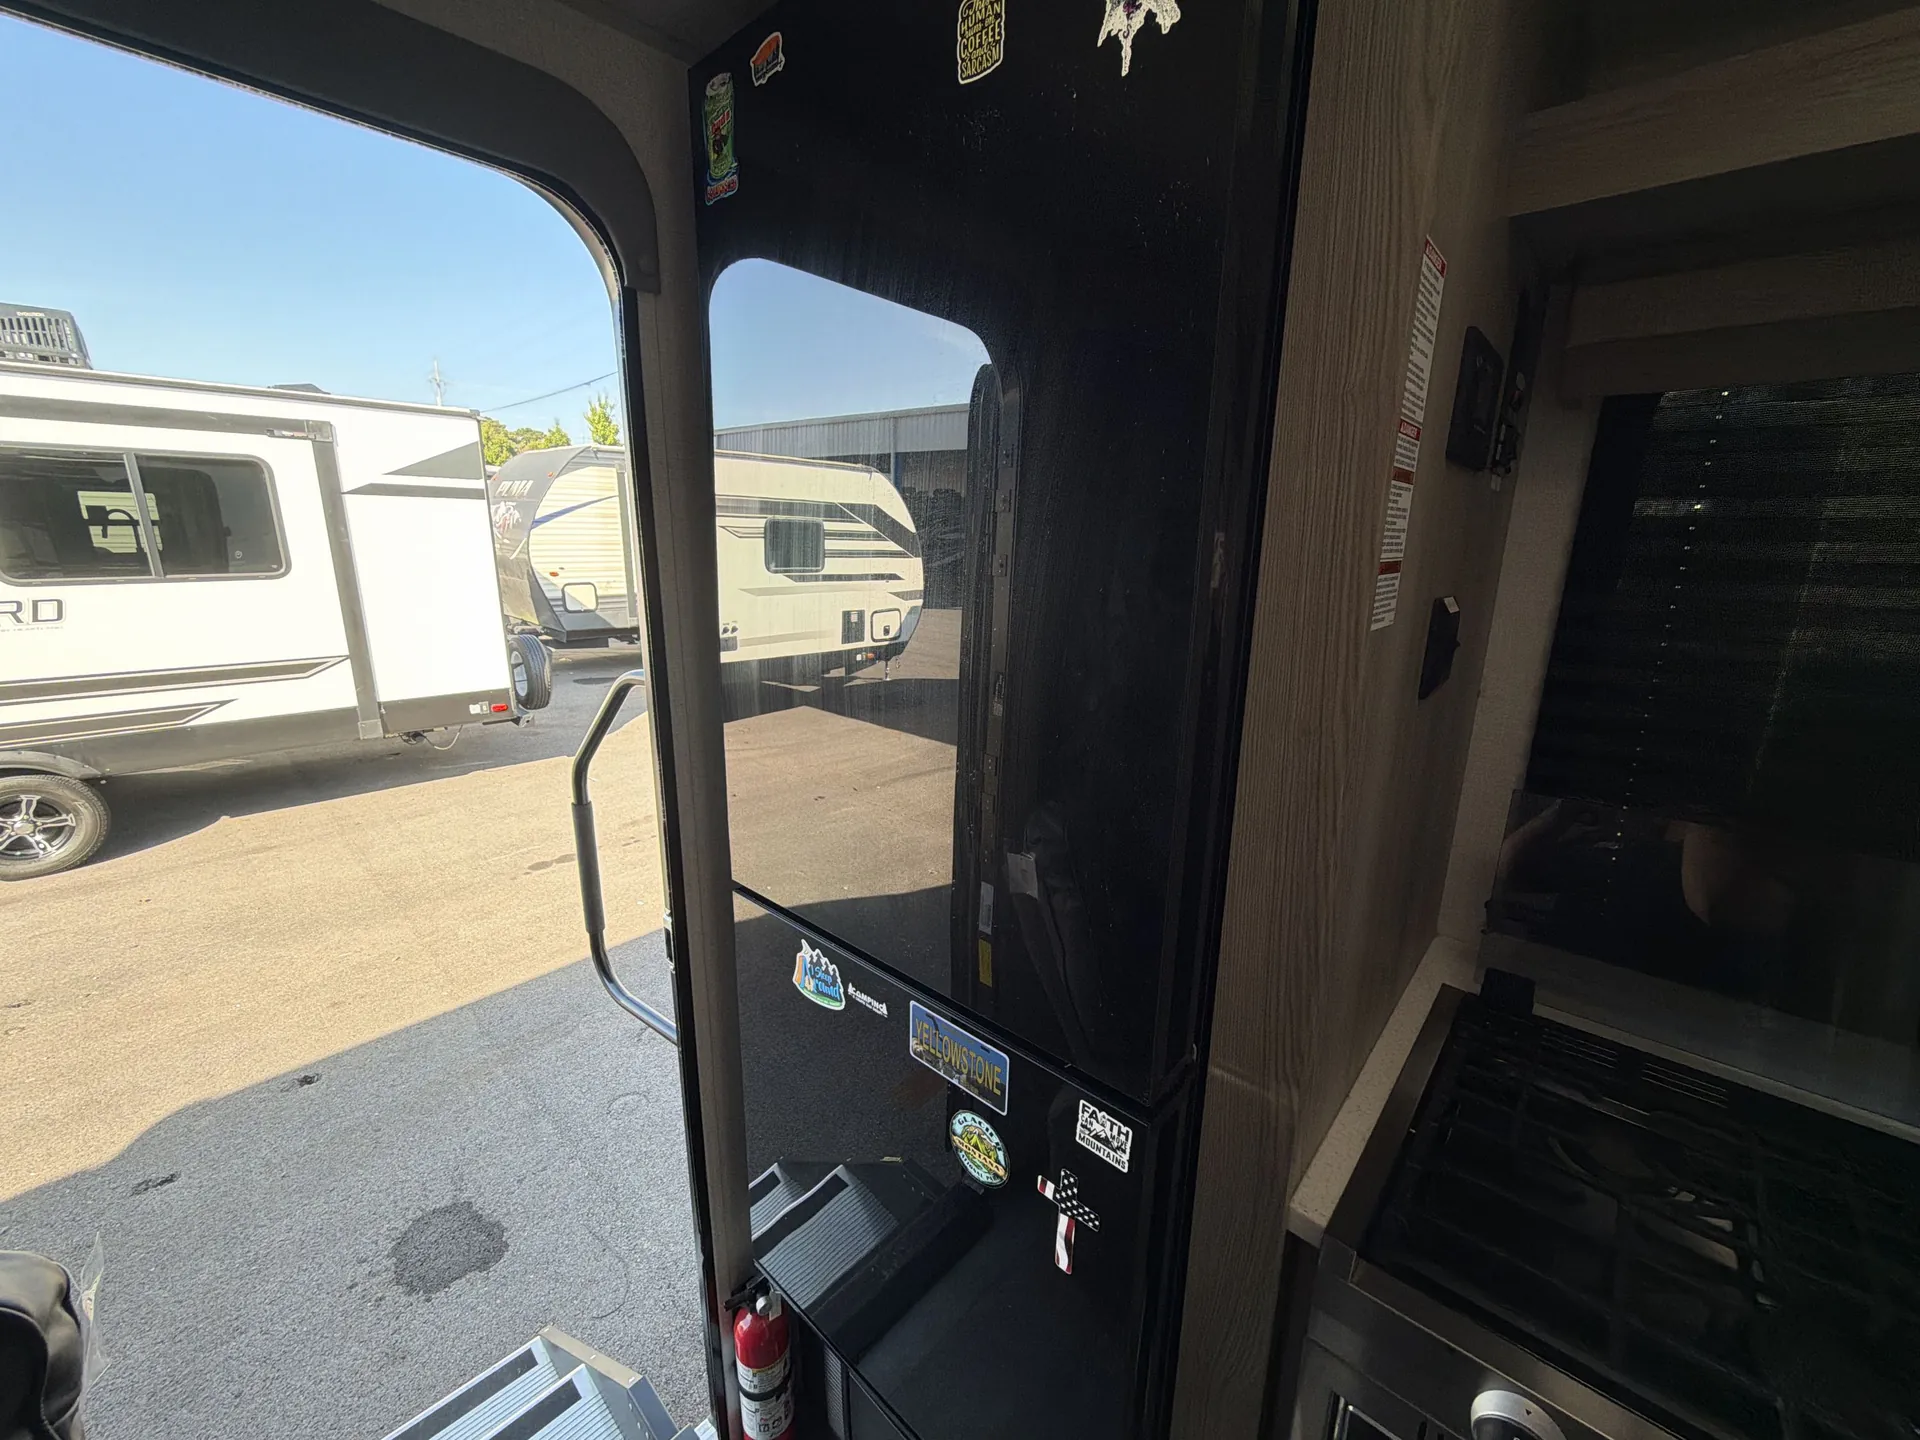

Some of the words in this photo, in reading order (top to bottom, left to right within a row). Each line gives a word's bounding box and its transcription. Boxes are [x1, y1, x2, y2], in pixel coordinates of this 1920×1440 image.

[961, 2, 1001, 34] HUMAN
[961, 18, 1001, 58] COFFEE
[961, 44, 999, 78] SARCASM
[916, 1018, 1002, 1096] YELLOWSTONE
[957, 1139, 1000, 1172] MONTANA
[1079, 1133, 1126, 1170] MOUNTAINS
